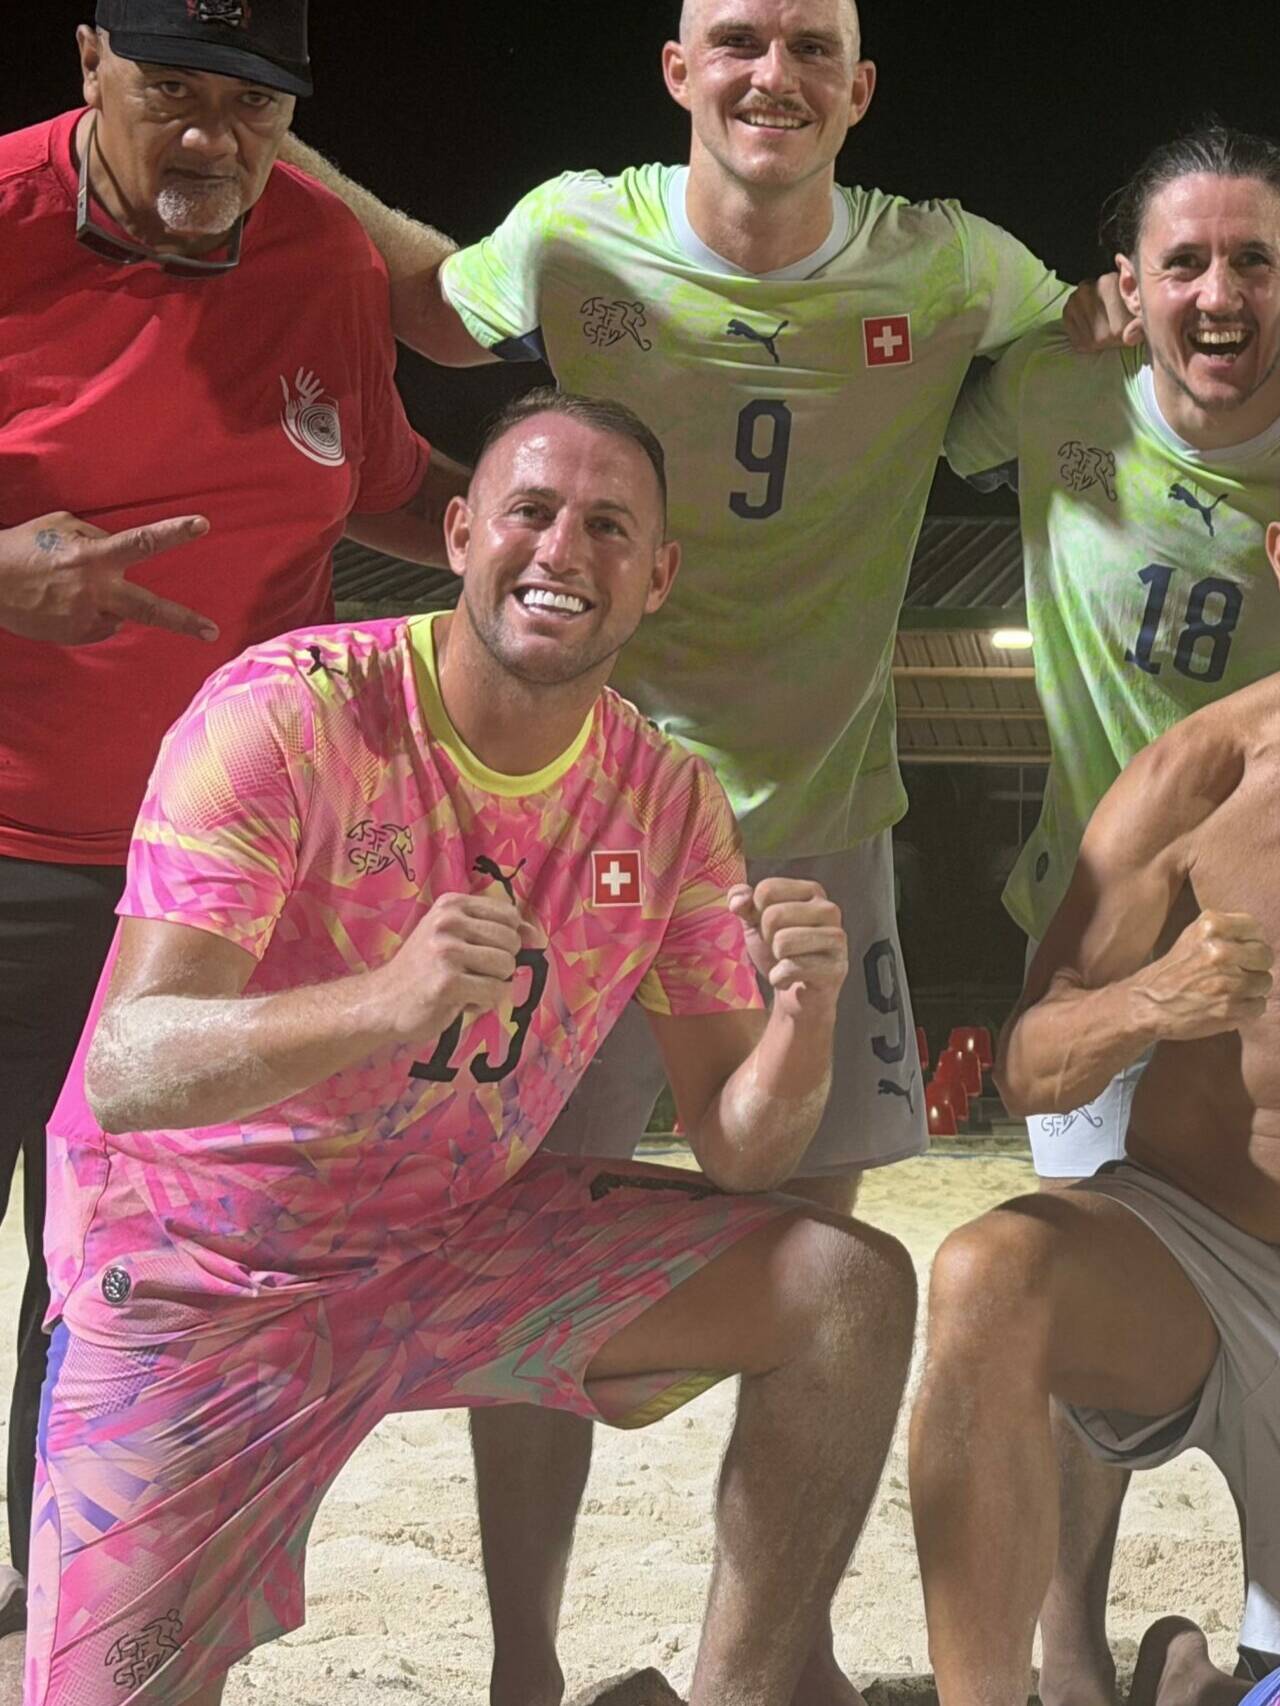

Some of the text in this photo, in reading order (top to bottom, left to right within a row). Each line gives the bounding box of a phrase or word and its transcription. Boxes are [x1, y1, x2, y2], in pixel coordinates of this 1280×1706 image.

[729, 399, 792, 519] 9
[1124, 563, 1243, 683] 18
[863, 938, 906, 1064] 9
